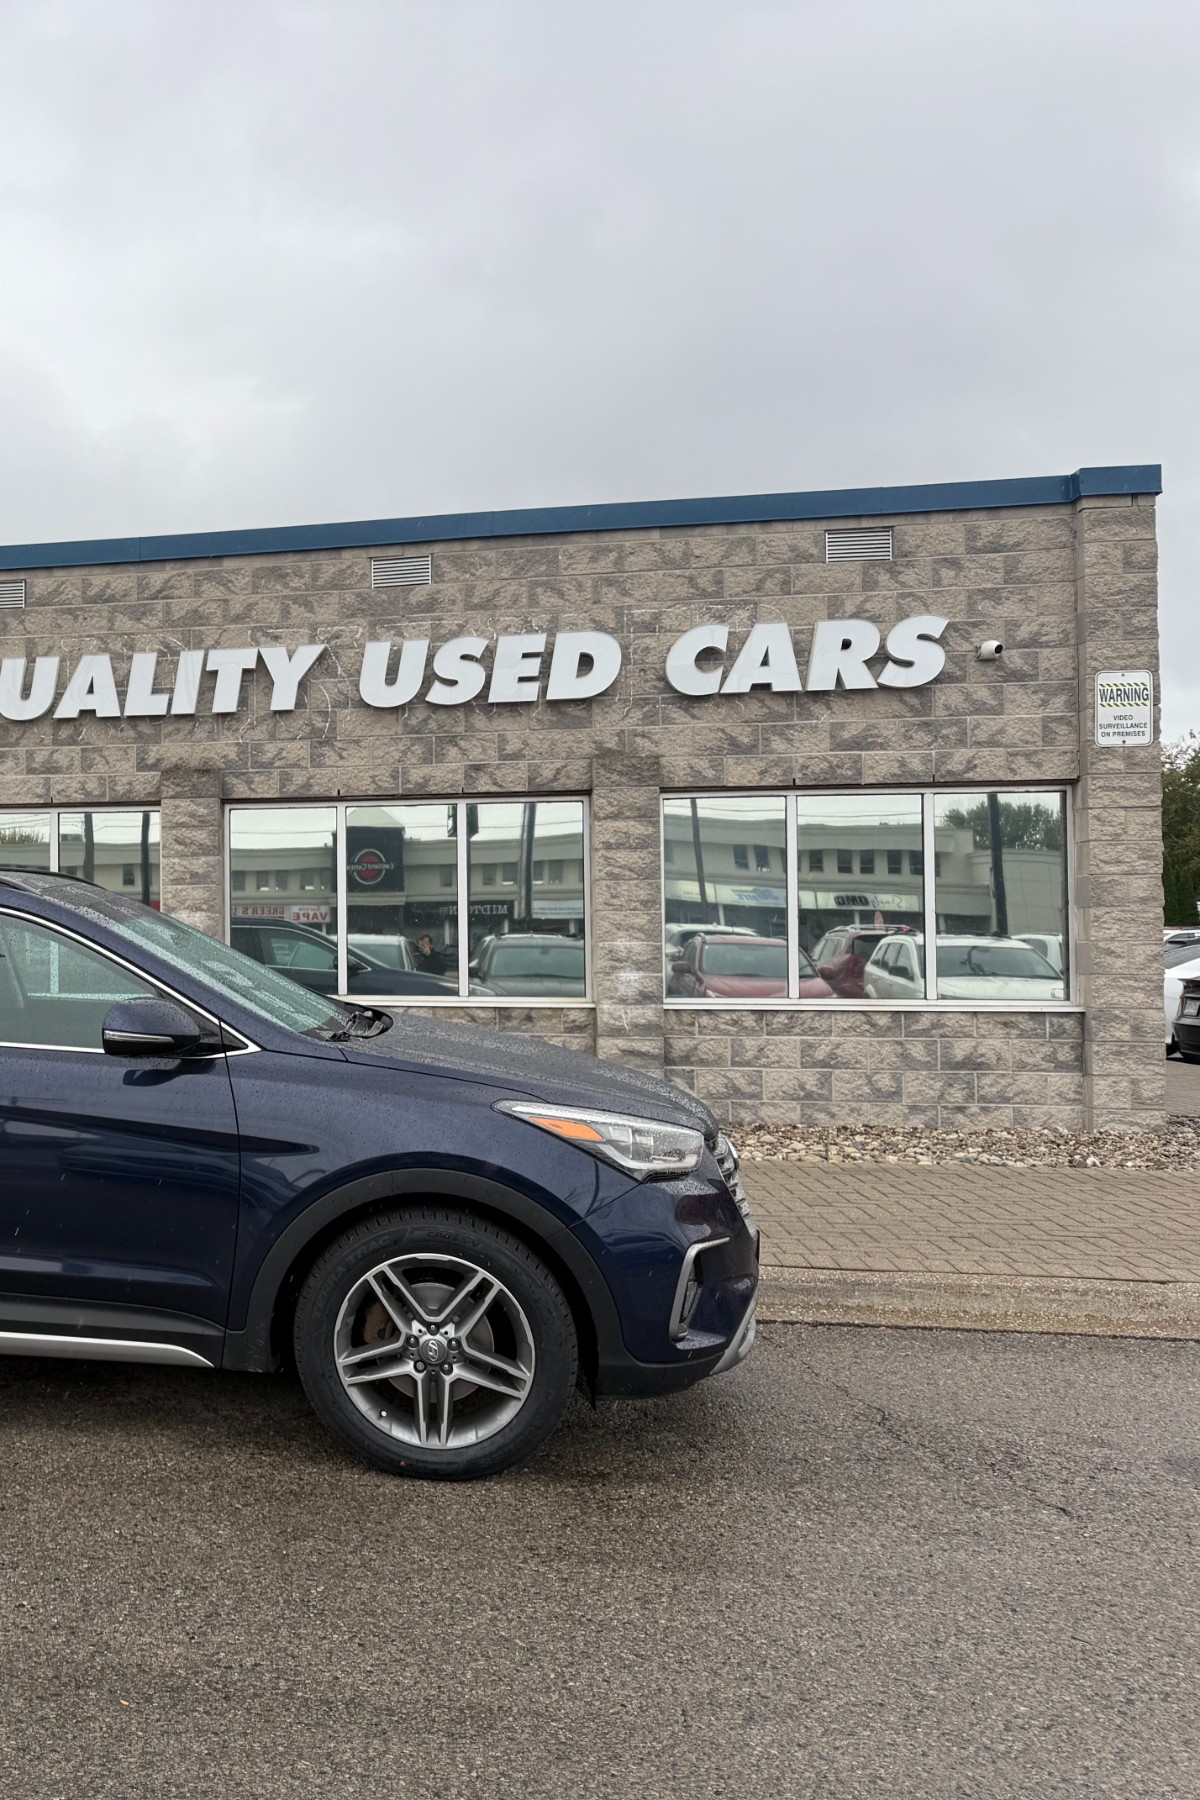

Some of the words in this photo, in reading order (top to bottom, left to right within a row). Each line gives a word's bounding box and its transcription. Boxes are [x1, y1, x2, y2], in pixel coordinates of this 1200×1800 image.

[358, 630, 622, 708] USED
[665, 615, 950, 697] CARS
[1099, 687, 1149, 703] WARNING
